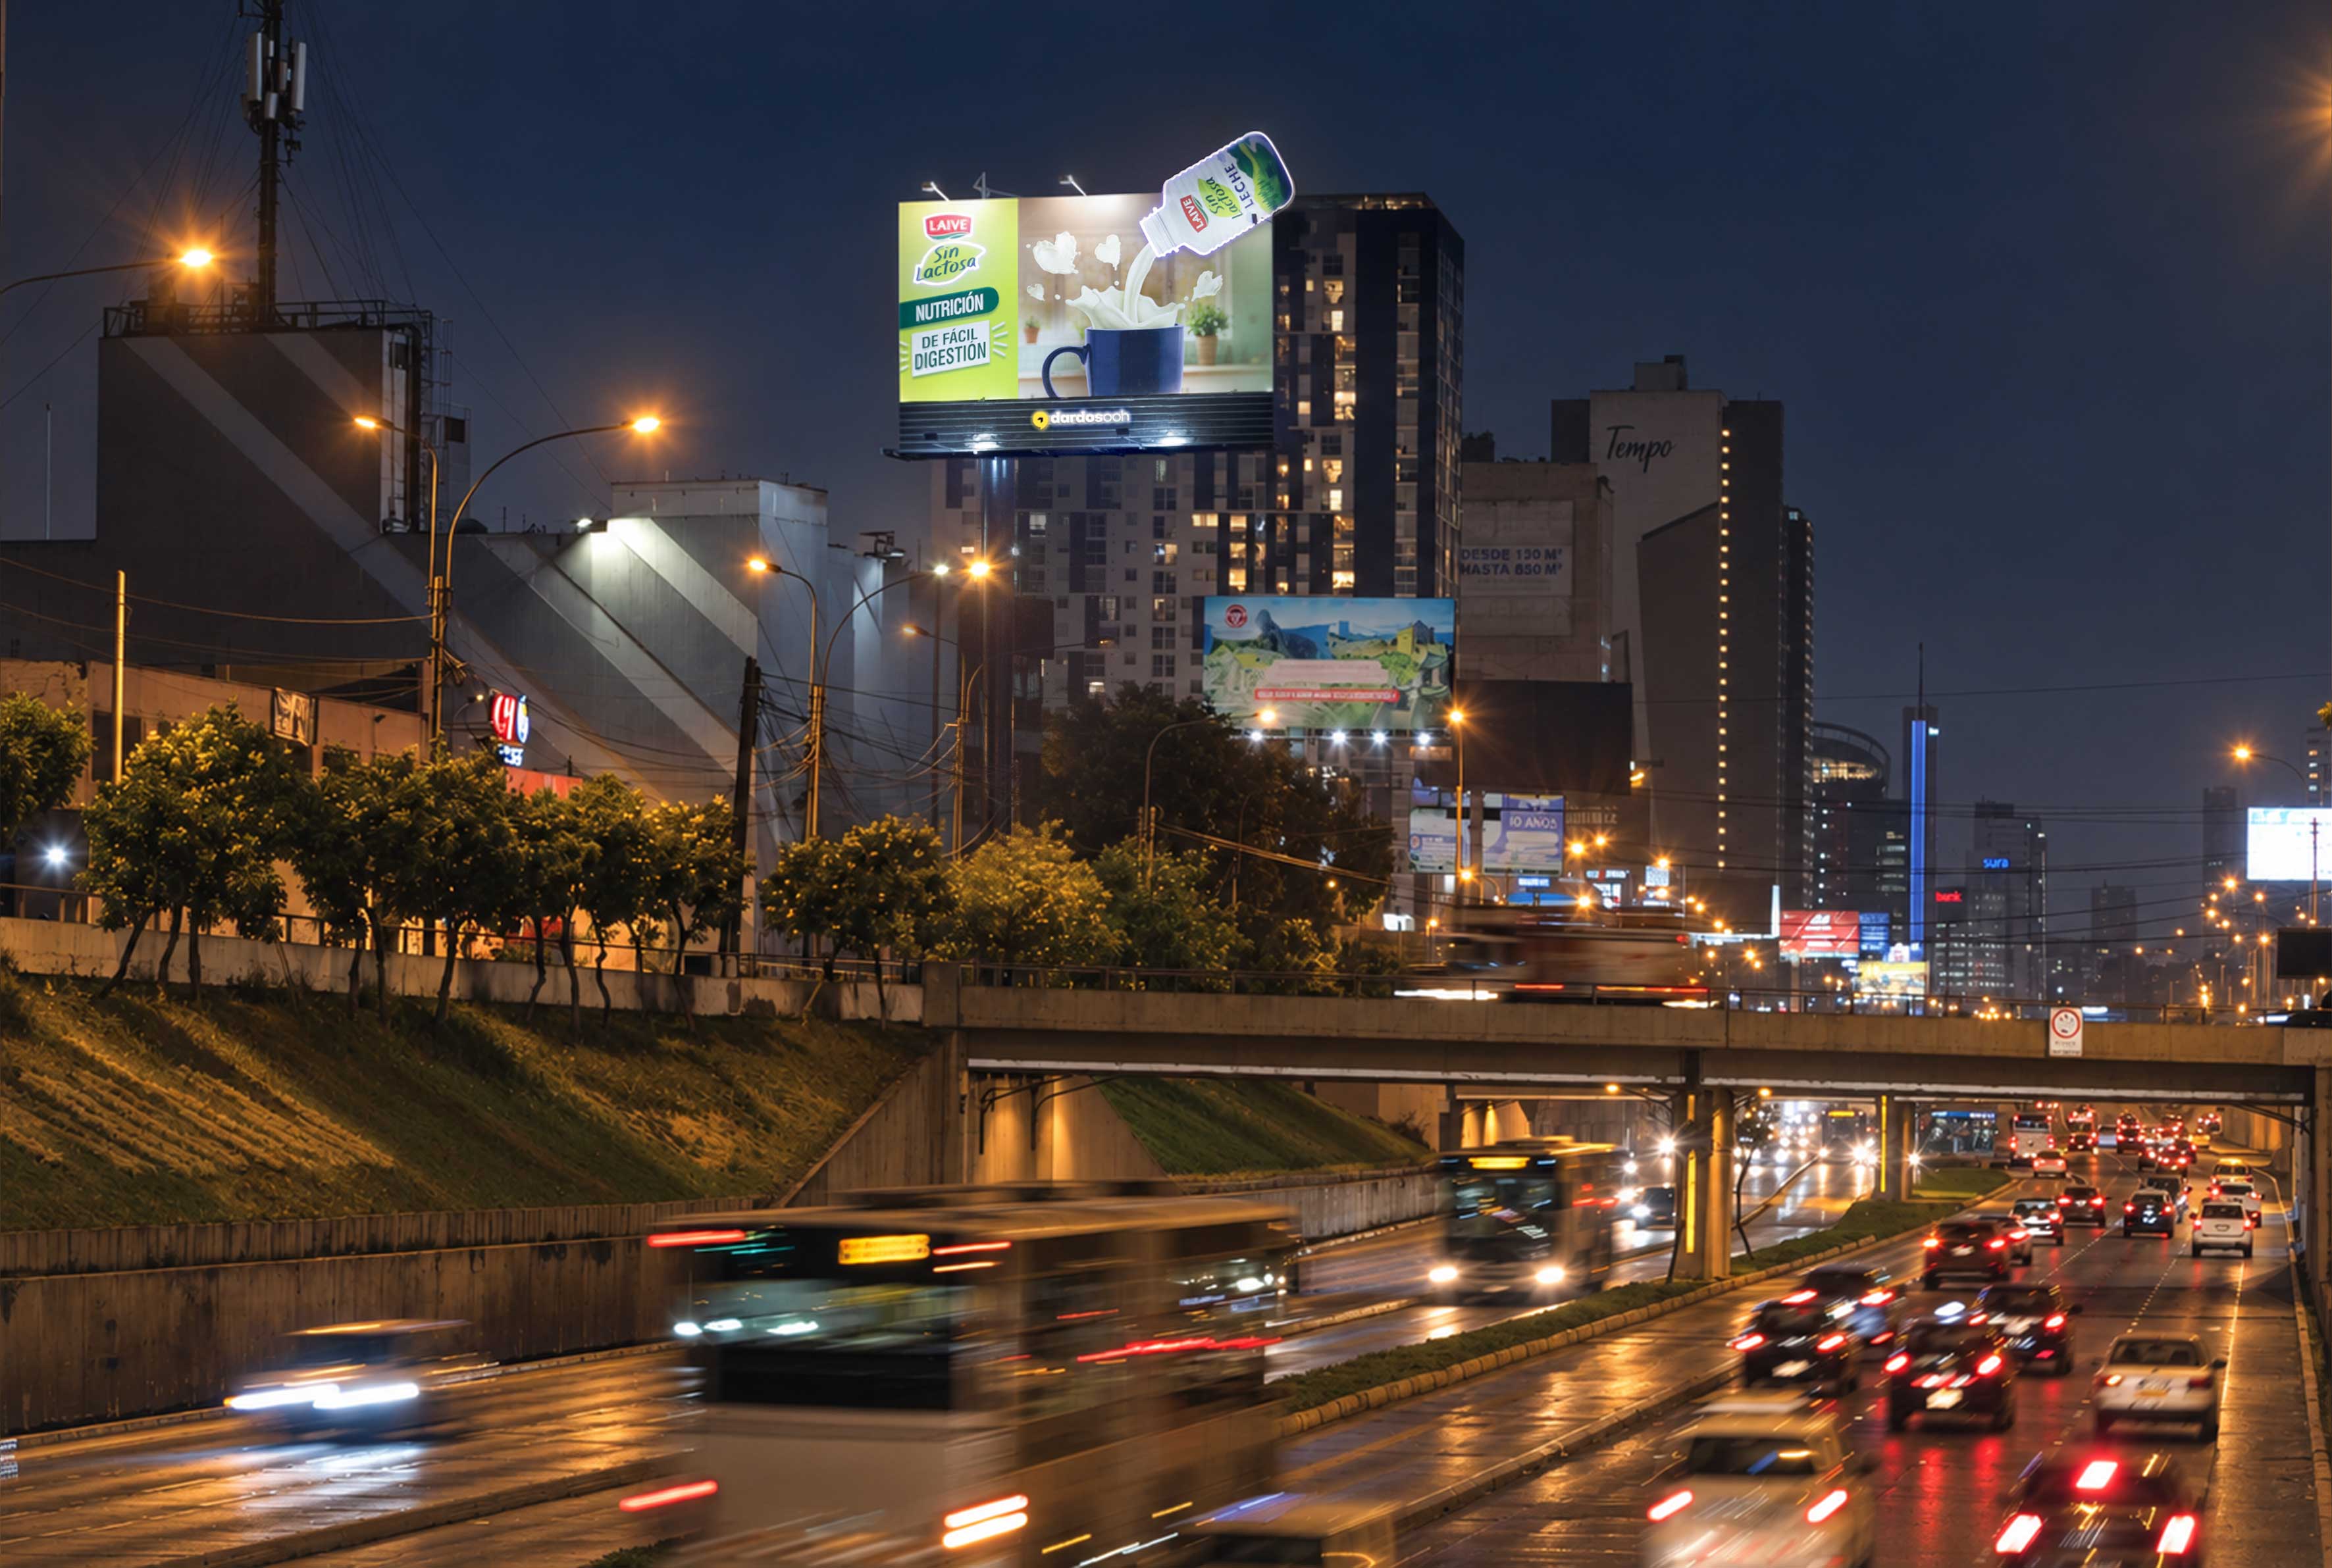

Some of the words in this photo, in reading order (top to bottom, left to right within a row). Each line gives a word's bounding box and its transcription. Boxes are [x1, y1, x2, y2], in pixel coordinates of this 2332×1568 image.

[1206, 176, 1243, 219] Lactosa
[1224, 163, 1254, 209] LECHE
[1183, 197, 1204, 230] LAIVE
[1205, 194, 1224, 215] Sin
[929, 219, 968, 232] LAIVE
[933, 245, 959, 263] Sin
[916, 257, 977, 282] Lactosa
[916, 291, 984, 322] NUTRICIÓN
[921, 334, 939, 349] DE
[943, 328, 978, 345] FÁCIL
[914, 341, 987, 370] DIGESTIÓN
[1050, 409, 1130, 424] dardosooh
[1607, 425, 1676, 474] Tempo
[1461, 549, 1510, 560] DESDE
[1460, 564, 1510, 575] HASTA
